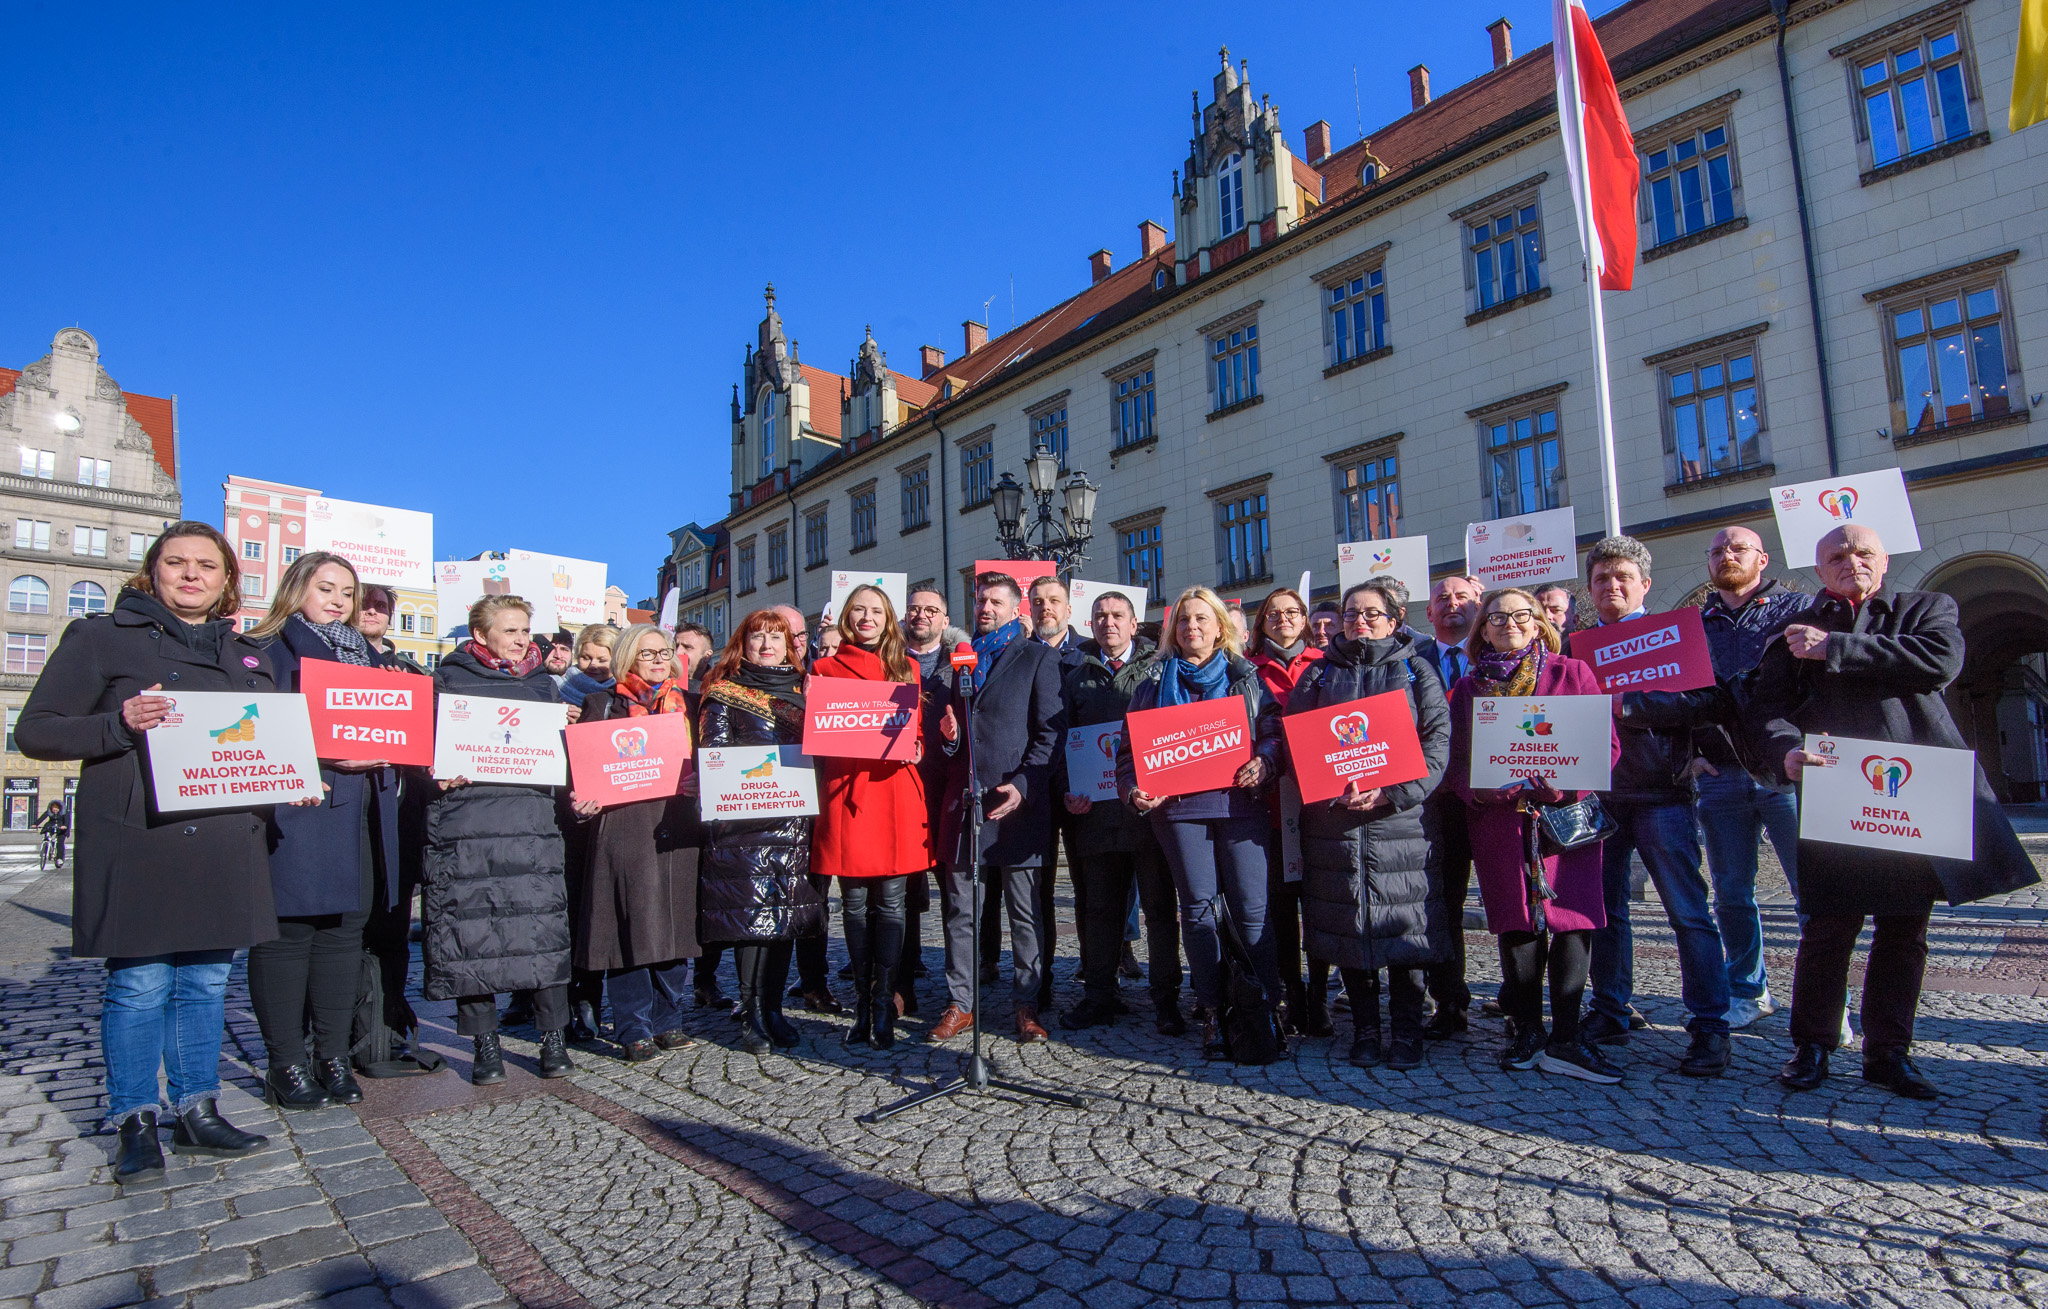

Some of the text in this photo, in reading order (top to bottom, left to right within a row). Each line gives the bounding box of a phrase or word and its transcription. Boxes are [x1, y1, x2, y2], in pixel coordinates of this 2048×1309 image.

[332, 540, 406, 557] PODNIESIENIE
[1490, 547, 1553, 563] PODNIESIENIE
[316, 549, 420, 569] NIMALNEJ RENTY
[1478, 555, 1566, 574] MINIMALNEJ RENTY
[352, 564, 404, 577] ERYTURY
[1497, 567, 1552, 581] EMERYTURY
[577, 597, 595, 606] BON
[1599, 630, 1676, 662] LEWICA
[1604, 662, 1681, 689] razem
[332, 691, 408, 706] LEWICA
[826, 702, 859, 710] LEWICA
[872, 700, 900, 708] TRASIE
[814, 712, 913, 729] WROCŁAW
[332, 723, 407, 745] razem
[1152, 719, 1227, 747] LEWICA W TRASIE
[455, 744, 491, 753] WALKA
[502, 746, 555, 758] DROŻYZNĄ
[1143, 729, 1242, 770] WROCŁAW
[1325, 741, 1390, 763] BEZPIECZNA
[1510, 743, 1559, 752] ZASIŁEK
[211, 750, 266, 762] DRUGA
[471, 755, 538, 766] I NIŻSZE RATY
[1489, 755, 1580, 766] POGRZEBOWY
[0, 759, 82, 770] IOTEK
[182, 764, 296, 780] WALORYZACJA
[476, 766, 533, 775] KREDYTÓW
[602, 757, 665, 773] BEZPIECZNA
[1336, 756, 1385, 774] RODZINA
[612, 770, 659, 783] RODZINA
[1509, 768, 1558, 779] 7000 ZŁ
[178, 779, 305, 797] RENT I EMERYTUR
[741, 781, 779, 790] DRUGA
[720, 790, 800, 801] WALORYZACJA
[716, 803, 743, 812] RENT
[751, 800, 806, 810] EMERYTUR
[1862, 806, 1911, 822] RENTA
[1850, 820, 1922, 838] WDOWIA
